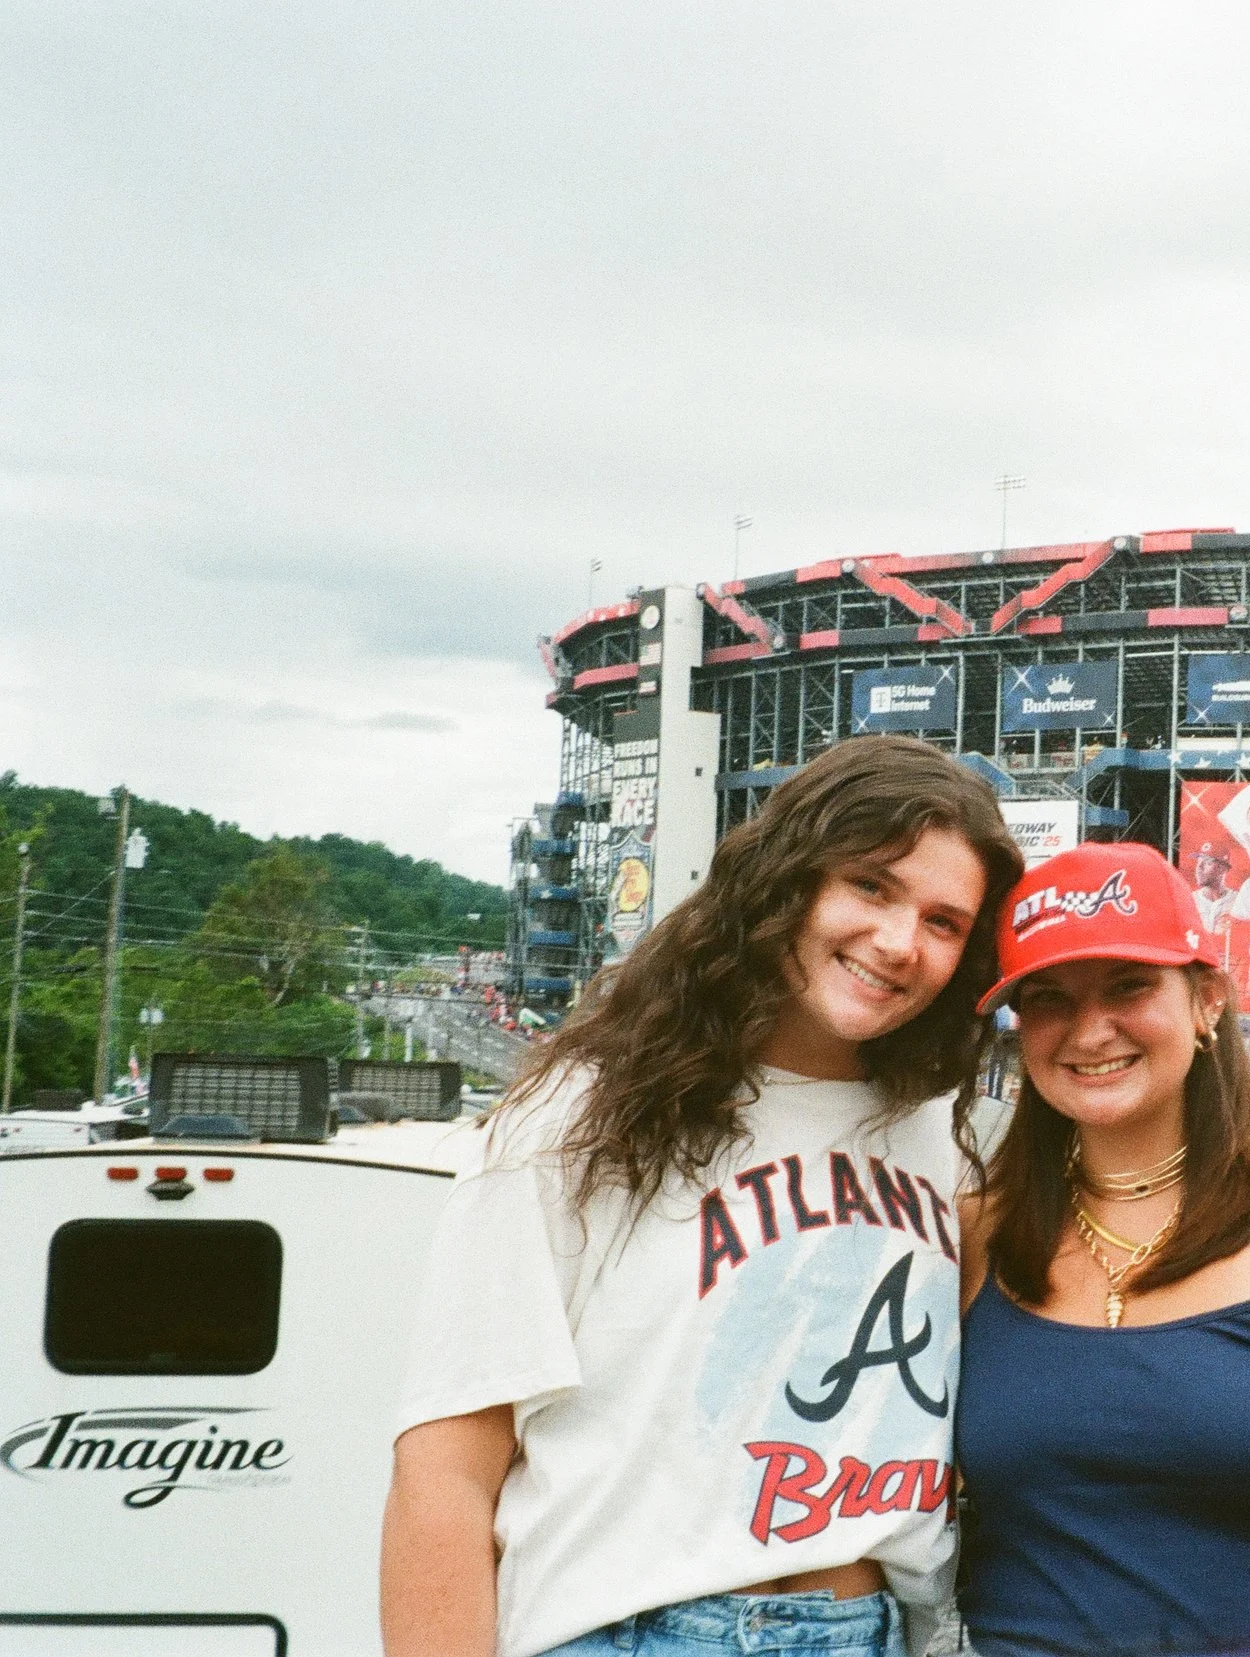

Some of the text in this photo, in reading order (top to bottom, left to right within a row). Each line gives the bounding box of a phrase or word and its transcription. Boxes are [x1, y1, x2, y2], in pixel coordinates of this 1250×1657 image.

[891, 684, 936, 697] 5G Home
[891, 699, 931, 711] Internet
[1022, 697, 1097, 714] Budweiser
[612, 777, 658, 799] EVERY
[1012, 886, 1062, 928] ATL
[785, 1251, 949, 1423] A
[25, 1411, 294, 1509] Imagine
